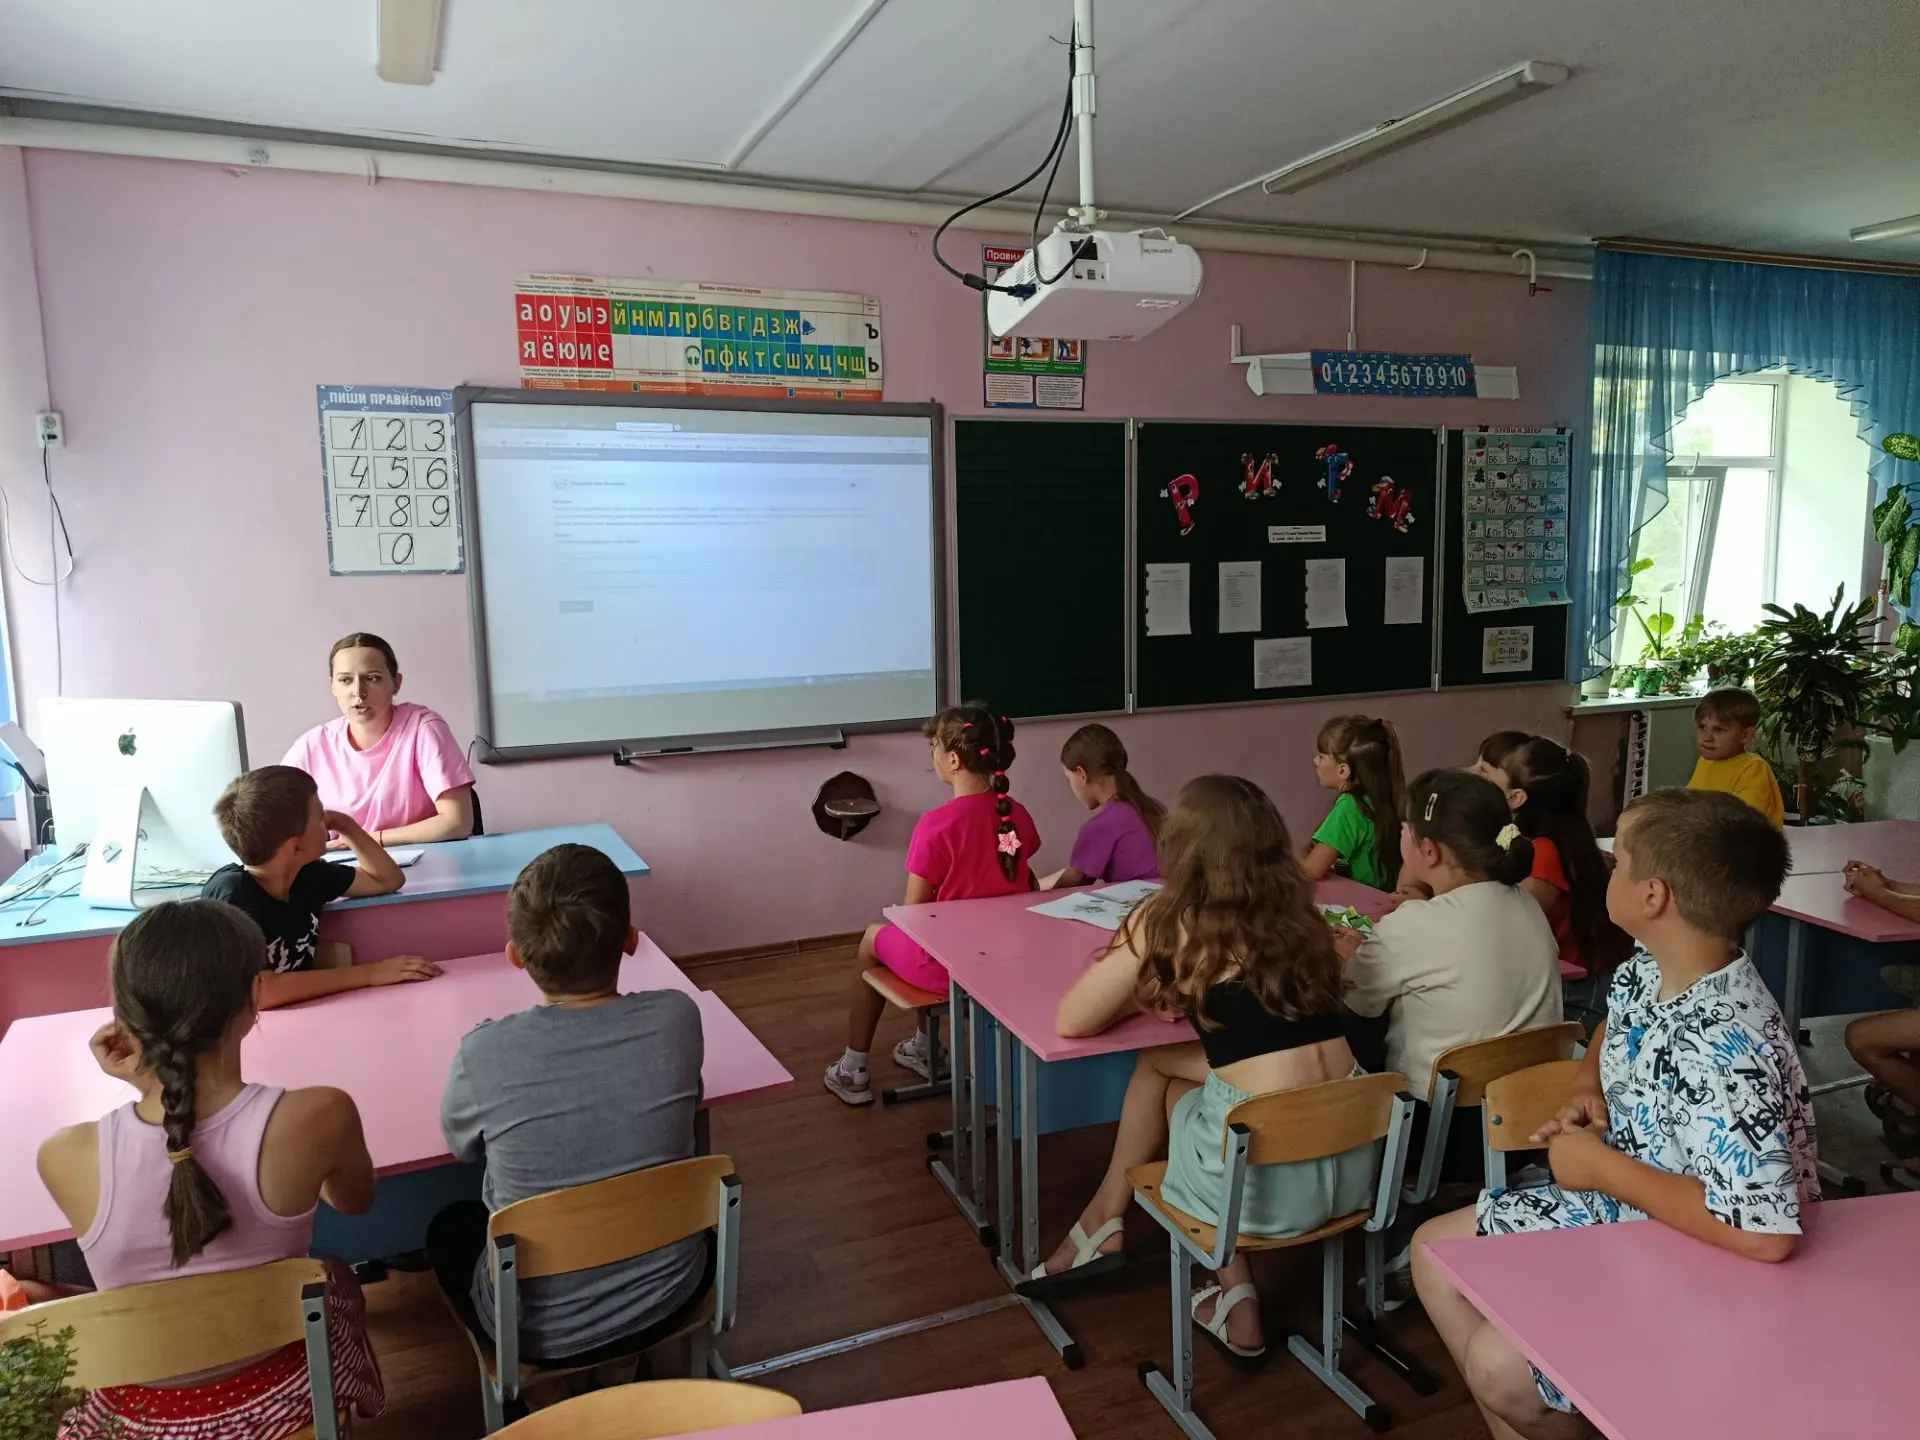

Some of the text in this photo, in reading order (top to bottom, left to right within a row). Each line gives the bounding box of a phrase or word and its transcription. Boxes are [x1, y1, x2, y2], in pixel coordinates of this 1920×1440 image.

[986, 248, 1023, 261] Правил
[1322, 362, 1466, 386] 0 1 2 3 4 5 6 7 8 9 10
[329, 391, 442, 407] ПИШИ ПРАВИЛЬНО
[350, 417, 445, 452] 1 2 3
[350, 456, 447, 490] 4 5 6
[349, 494, 449, 527] 7 8 9
[391, 533, 413, 565] 0
